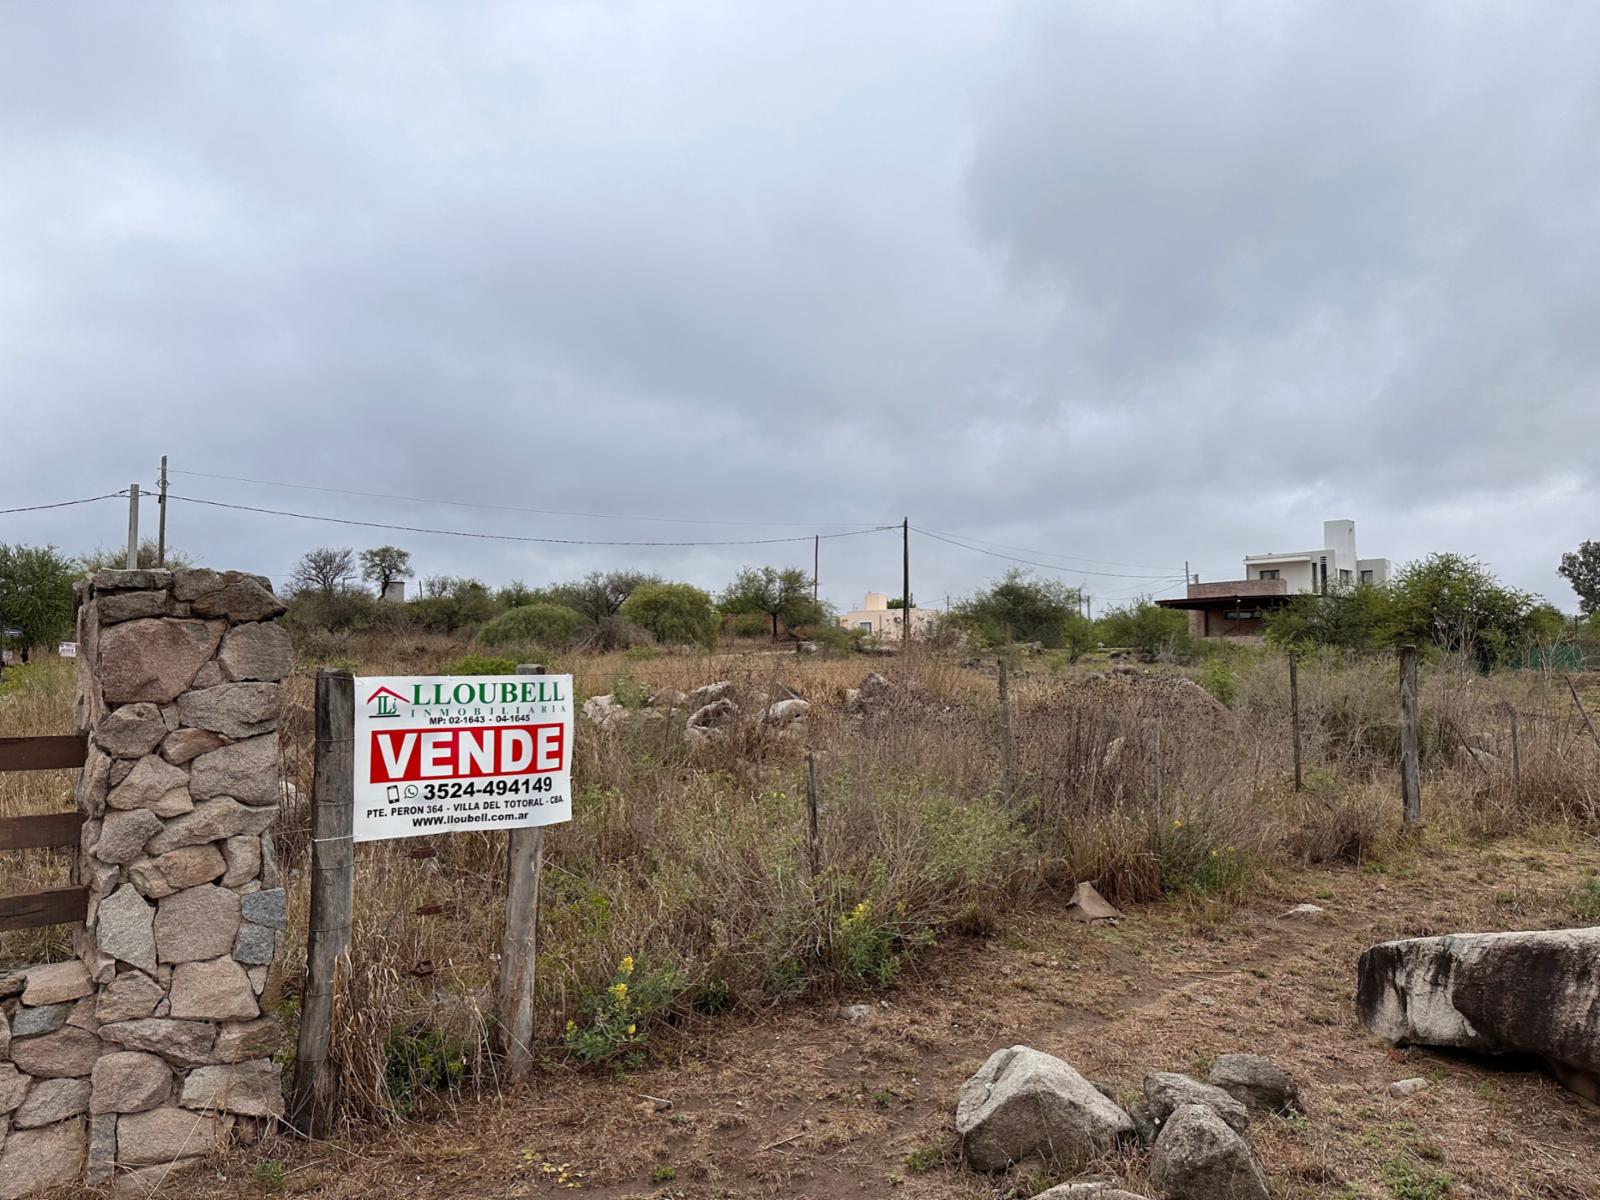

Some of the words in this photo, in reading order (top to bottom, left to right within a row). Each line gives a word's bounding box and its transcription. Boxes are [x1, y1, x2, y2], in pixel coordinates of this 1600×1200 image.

[412, 682, 565, 706] LLOUBELL
[411, 705, 566, 718] INMOBILIARIA
[429, 717, 446, 725] MP:
[448, 716, 486, 725] 02-1643
[495, 714, 531, 723] 04-1645
[376, 726, 561, 780] VENDE
[423, 777, 553, 801] 3524-494149
[366, 808, 388, 819] PTE.
[390, 806, 424, 817] PERON
[426, 804, 444, 814] 364
[453, 802, 480, 812] VILLA
[483, 800, 501, 810] DEL
[504, 798, 544, 809] TOTORAL
